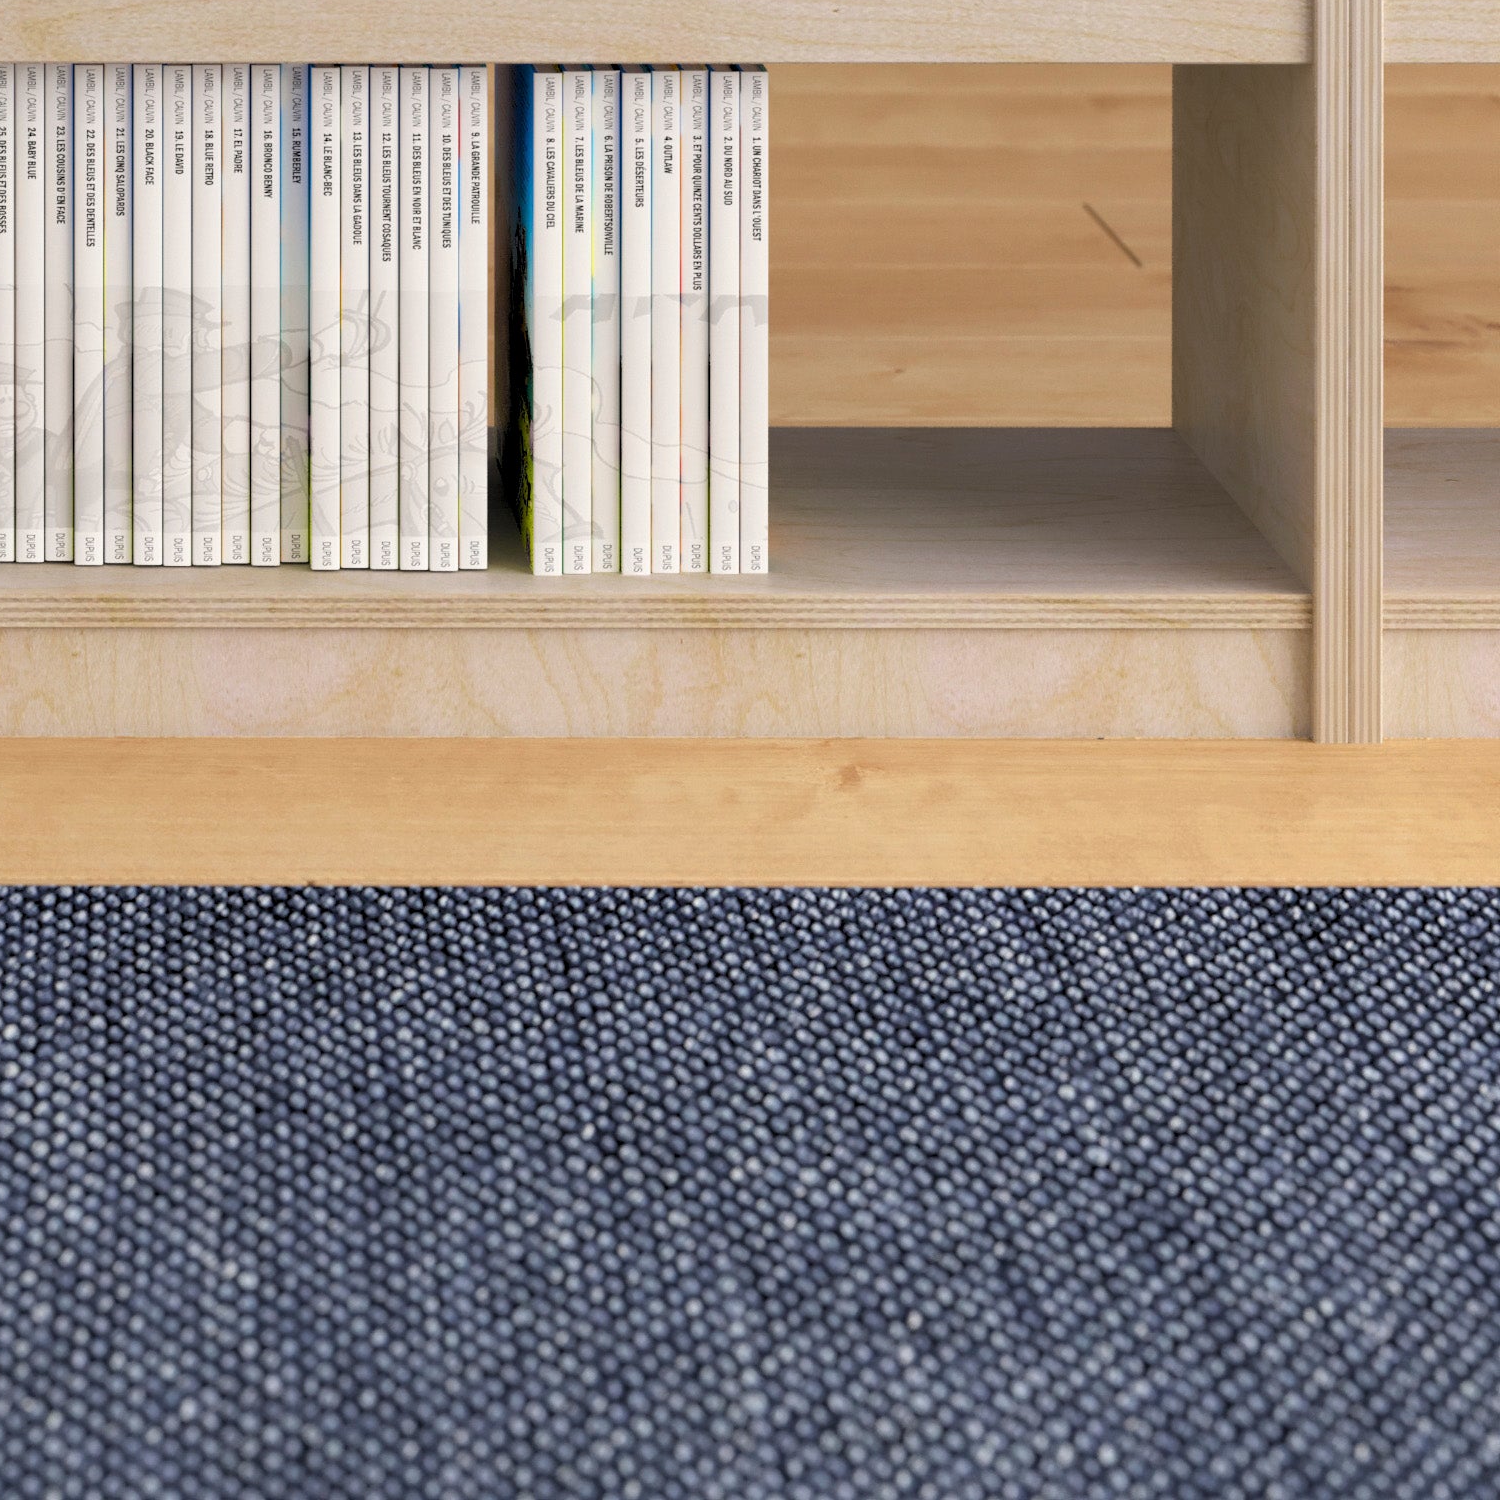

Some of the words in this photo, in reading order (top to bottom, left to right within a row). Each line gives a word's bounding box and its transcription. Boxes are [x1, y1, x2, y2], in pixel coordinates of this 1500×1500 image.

[751, 75, 762, 100] LAMBIL
[751, 106, 762, 131] CAUVIN
[27, 127, 37, 139] 24.
[204, 130, 214, 141] 18.
[545, 137, 556, 145] 8.
[603, 135, 614, 143] 6.
[663, 135, 673, 143] 4.
[27, 140, 37, 160] BABY
[204, 142, 214, 162] BLUE
[471, 140, 481, 150] LA
[545, 146, 556, 160] LES
[604, 144, 614, 153] LA
[752, 145, 762, 156] UN
[471, 150, 481, 181] GRANDE
[603, 154, 614, 182] PRISON
[663, 144, 673, 174] OUTLAW
[27, 160, 37, 180] BLUE
[204, 162, 214, 186] RETRO
[752, 157, 762, 189] CHARIOT
[545, 161, 556, 200] CAVALIERS
[604, 182, 614, 193] DE
[470, 181, 481, 224] PATROUILLE
[545, 201, 556, 212] DU
[752, 189, 762, 210] DANS
[545, 213, 556, 230] CIEL
[603, 193, 614, 256] ROBERTSONVILLE
[750, 546, 760, 570] DUPUIS
